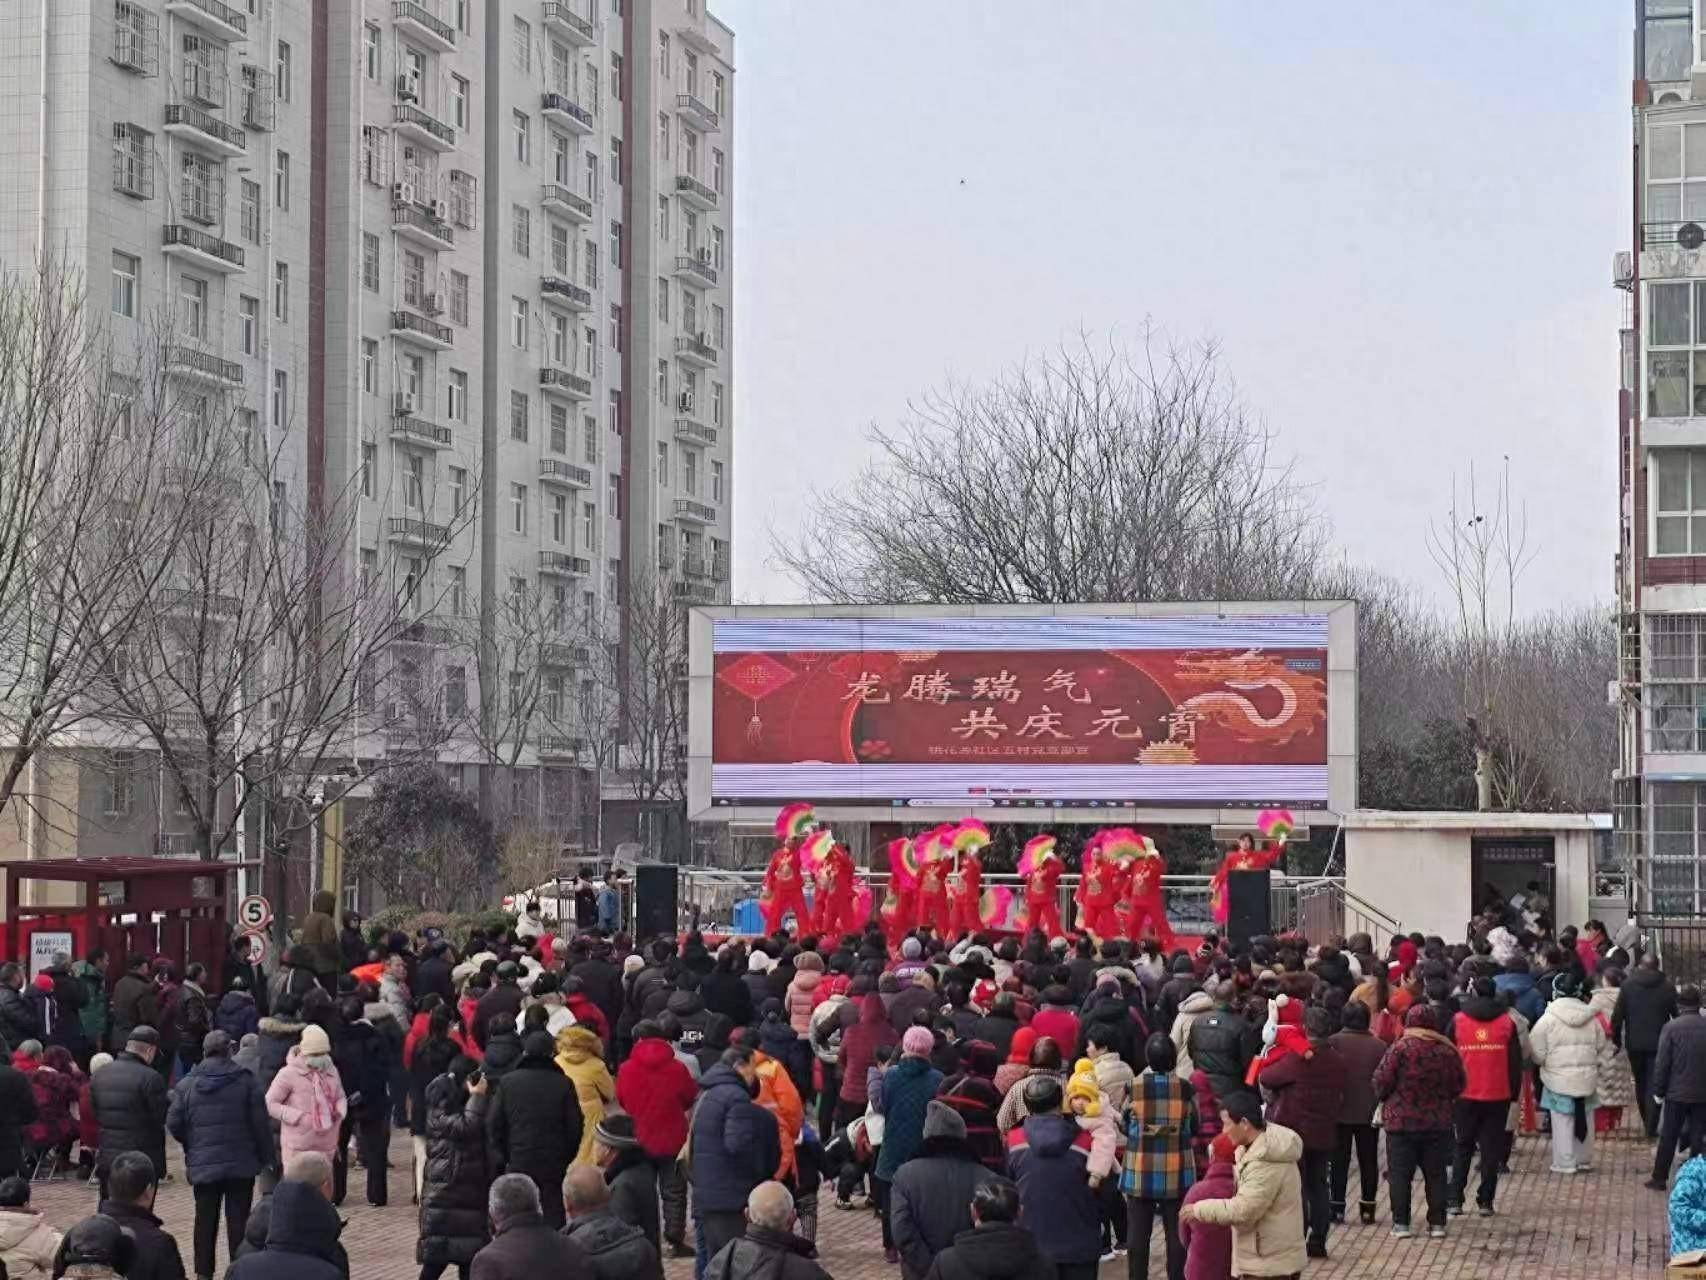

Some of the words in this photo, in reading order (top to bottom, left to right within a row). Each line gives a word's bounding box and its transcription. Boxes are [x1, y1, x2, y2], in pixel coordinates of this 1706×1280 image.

[841, 669, 1091, 704] 龙腾瑞气
[952, 704, 1205, 743] 共庆元宵
[248, 903, 262, 922] 5
